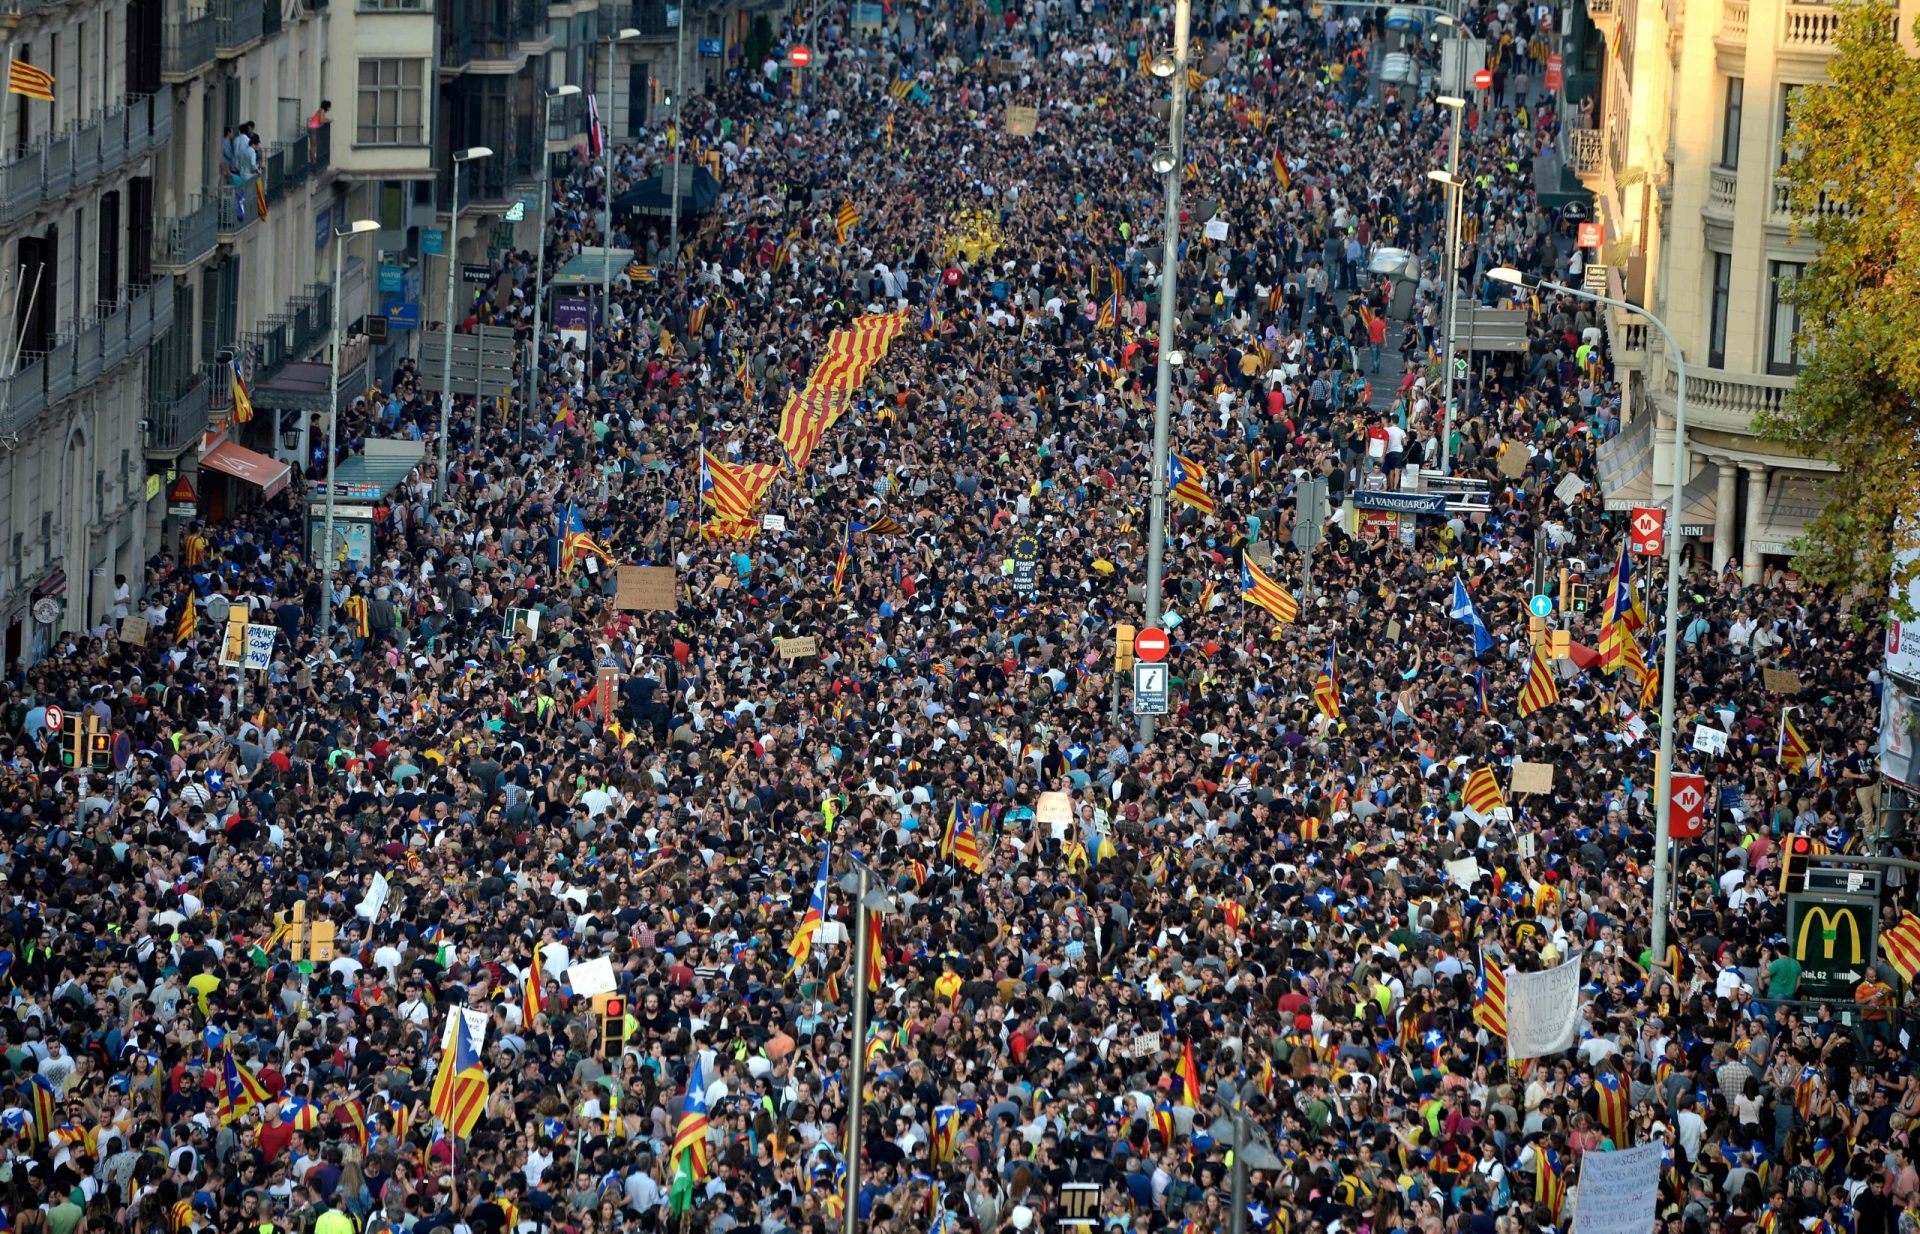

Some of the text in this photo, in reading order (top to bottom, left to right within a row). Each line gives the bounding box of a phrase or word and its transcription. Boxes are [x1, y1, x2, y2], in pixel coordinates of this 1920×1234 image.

[464, 271, 490, 279] TIGER
[1364, 496, 1436, 510] LA VANGUARDIA
[1640, 519, 1652, 530] M
[1682, 792, 1695, 805] M
[1817, 971, 1827, 980] 62
